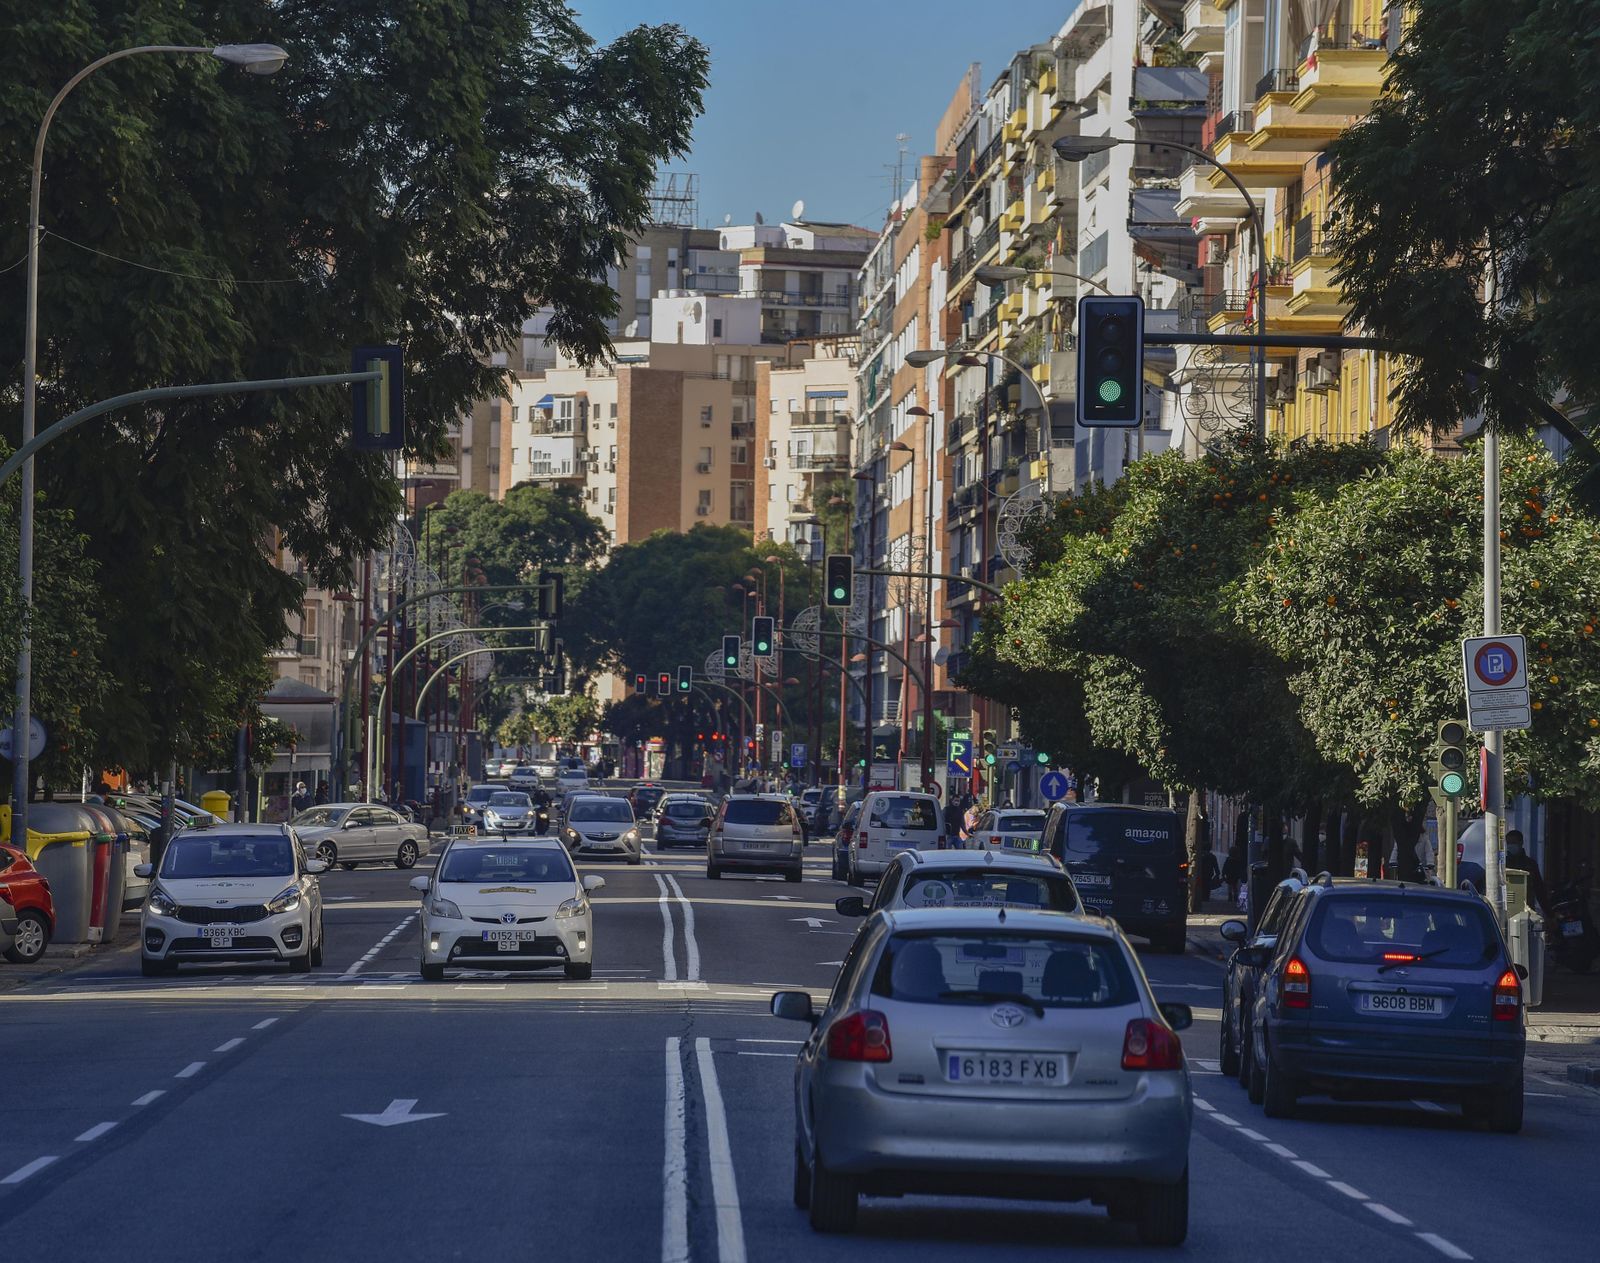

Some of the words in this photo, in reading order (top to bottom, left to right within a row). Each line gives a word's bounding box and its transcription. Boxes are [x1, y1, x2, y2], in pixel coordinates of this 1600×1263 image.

[1125, 828, 1169, 839] amazon
[1012, 838, 1031, 849] TAXI
[1086, 897, 1113, 905] Eléctrico
[203, 928, 226, 937] 9366
[228, 927, 245, 936] KBC
[490, 931, 512, 940] 0152
[515, 931, 532, 940] HLG
[1372, 995, 1406, 1010] 9608
[1409, 997, 1435, 1012] BBM
[963, 1058, 1013, 1078] 6183
[1020, 1059, 1058, 1079] FXB
